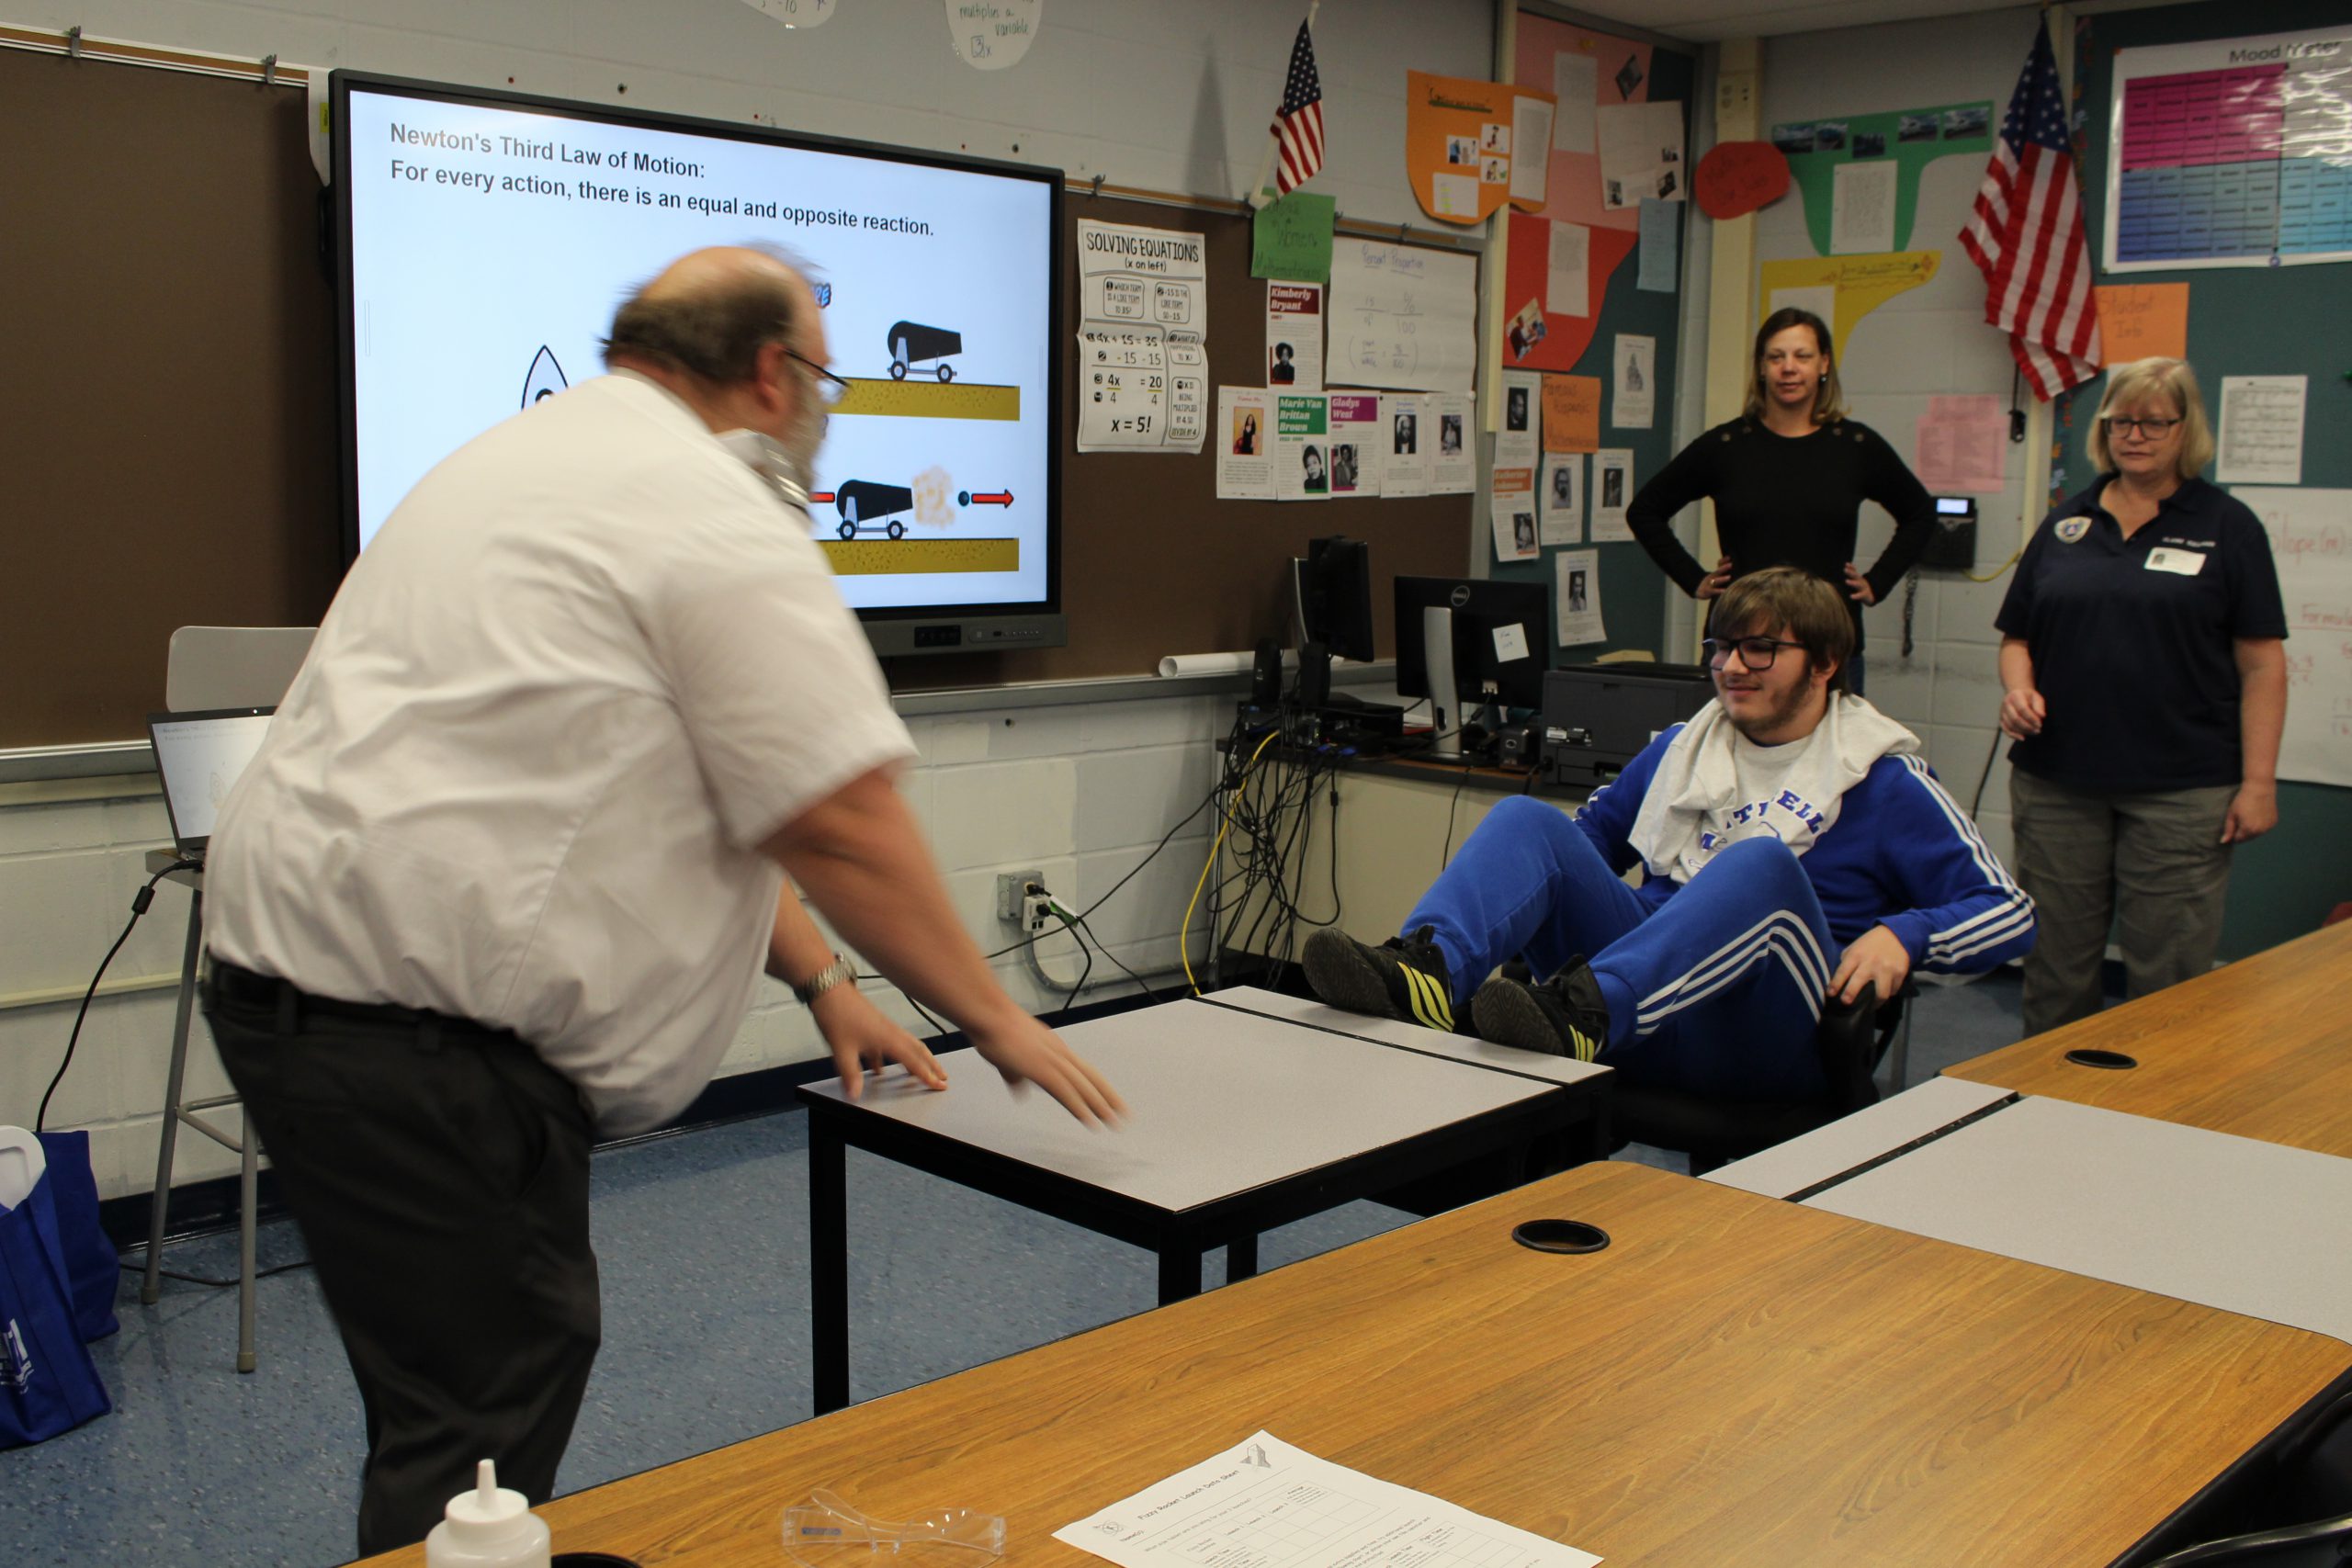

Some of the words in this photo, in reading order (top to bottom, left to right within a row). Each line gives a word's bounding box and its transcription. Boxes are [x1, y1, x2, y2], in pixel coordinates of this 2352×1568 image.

[2229, 44, 2280, 64] Mood
[390, 122, 491, 153] Newton's
[499, 135, 552, 160] Third
[561, 144, 602, 166] Law
[607, 151, 628, 169] of
[634, 152, 706, 178] Motion:
[391, 160, 428, 182] For
[435, 170, 495, 193] every
[502, 175, 571, 200] action,
[578, 181, 629, 203] there
[636, 186, 652, 206] is
[658, 194, 681, 209] an
[687, 197, 738, 216] equal
[743, 202, 776, 220] and
[782, 208, 858, 228] opposite
[863, 217, 934, 236] reaction.
[1086, 232, 1138, 256] SOLVING
[1138, 239, 1199, 263] EQUATIONS
[1125, 258, 1134, 269] (x
[1136, 261, 1146, 269] on
[1148, 259, 1167, 272] left)
[1272, 287, 1312, 301] Kimberly
[1272, 299, 1302, 311] Bryant
[1145, 334, 1158, 347] 35
[1107, 374, 1120, 387] 4x
[1148, 376, 1162, 389] 20
[1280, 398, 1305, 409] Marie
[1306, 399, 1323, 409] Van
[1331, 398, 1361, 412] Gladys
[1279, 411, 1311, 420] Brittan
[1331, 409, 1353, 420] West
[1111, 420, 1121, 433] x
[1136, 416, 1151, 434] 5!
[1279, 423, 1308, 432] Brown
[2266, 512, 2315, 566] Slope
[1136, 1508, 1159, 1520] Fizzy
[1155, 1497, 1182, 1510] Rocket
[1179, 1486, 1204, 1499] Launch
[1218, 1469, 1240, 1480] Sheet
